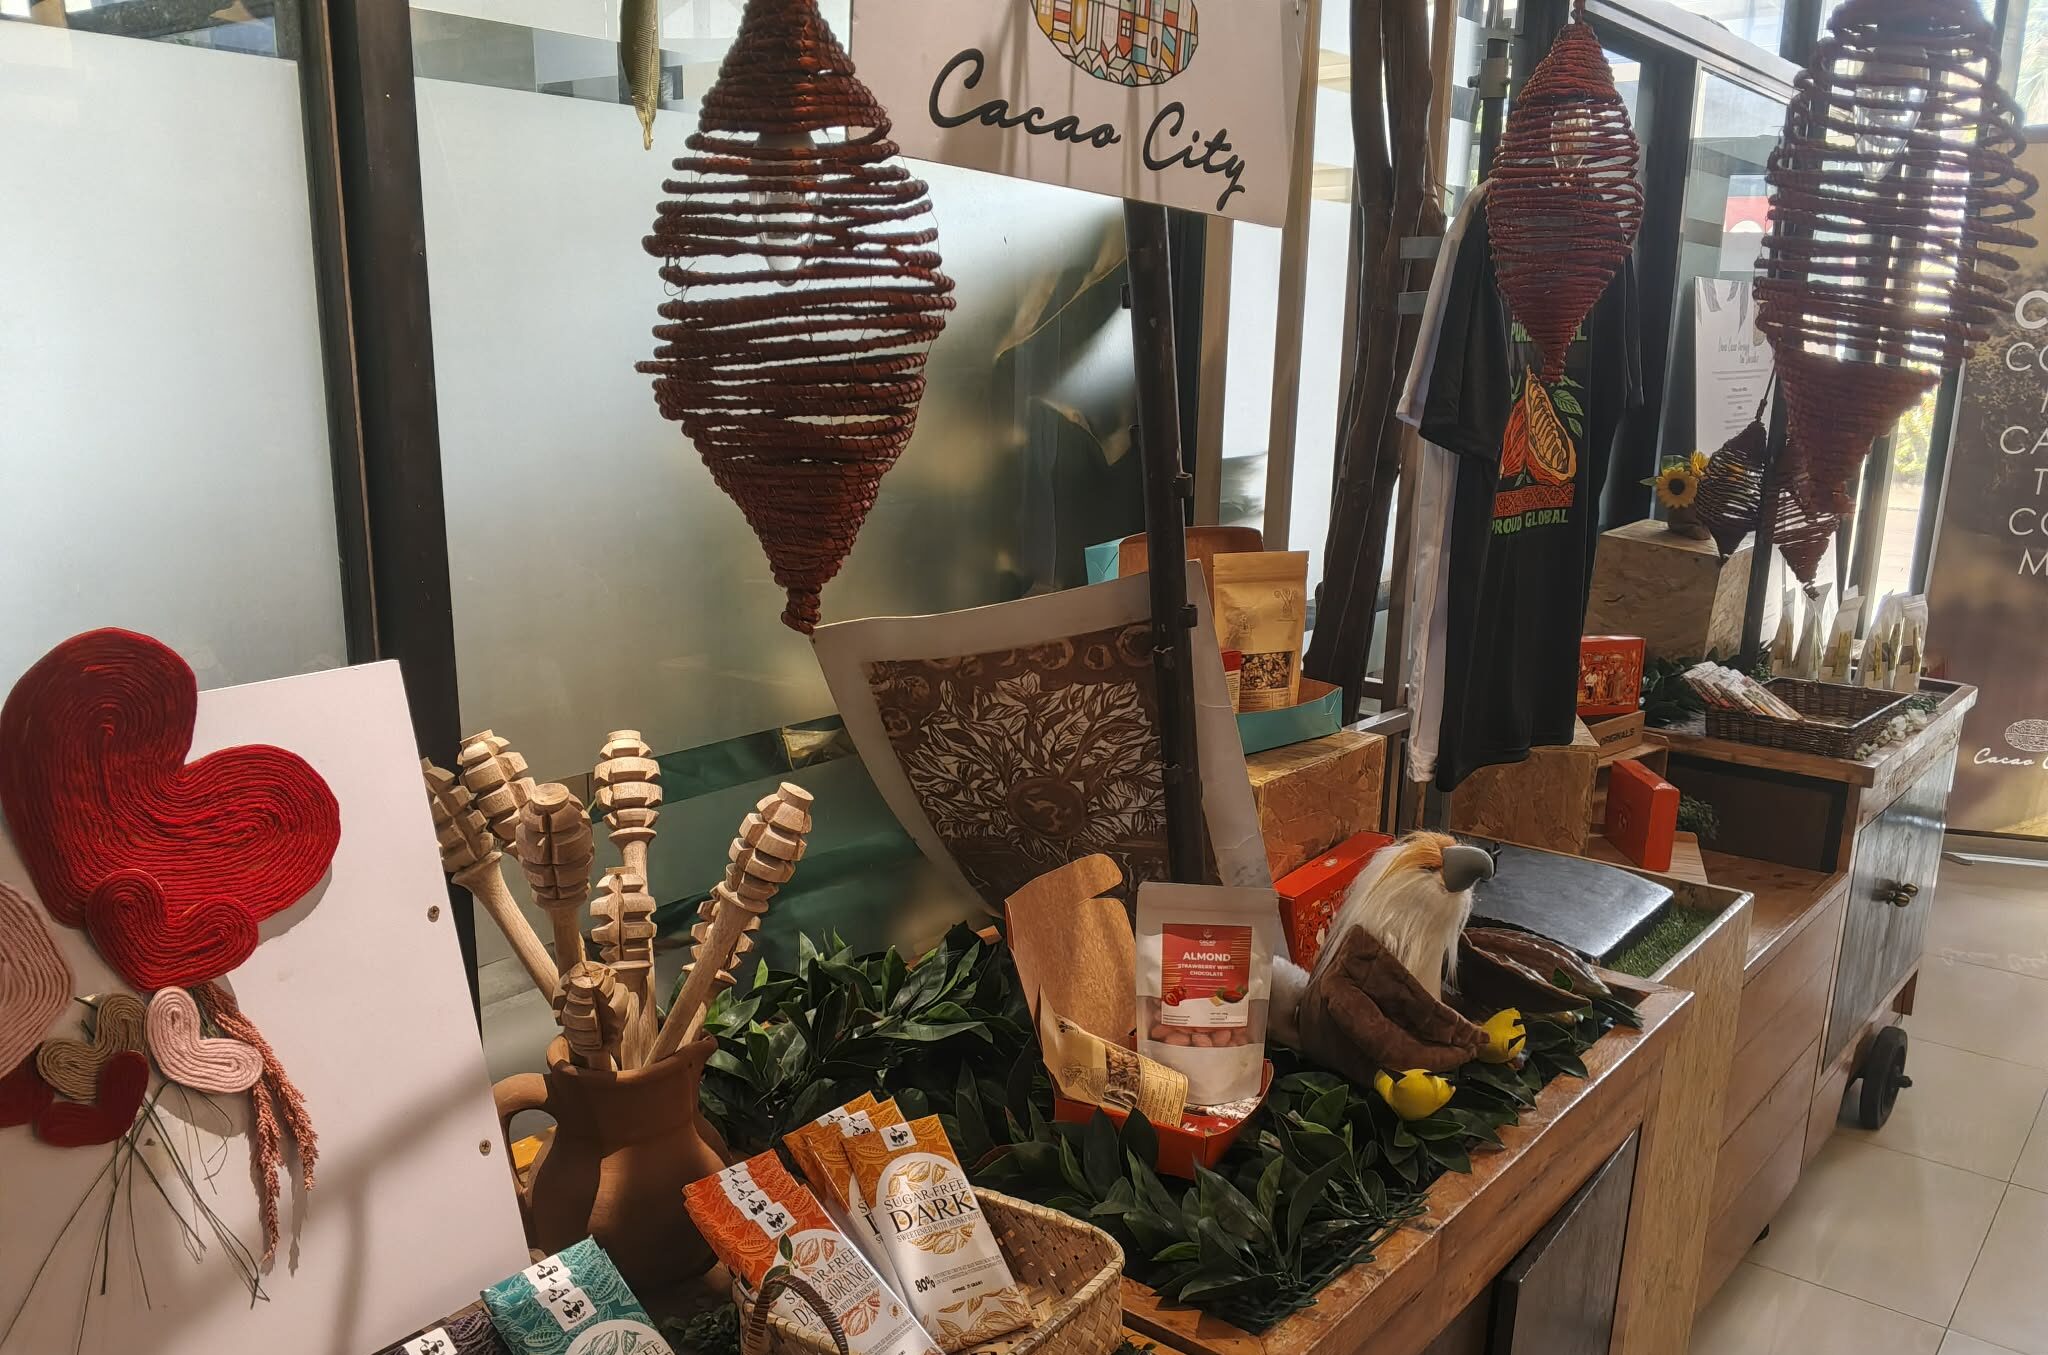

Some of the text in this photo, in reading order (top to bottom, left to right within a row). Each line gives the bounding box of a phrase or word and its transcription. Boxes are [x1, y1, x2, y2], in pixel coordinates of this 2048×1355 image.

[929, 48, 1246, 211] Cacao City
[1525, 509, 1568, 528] GLOBAL
[1974, 747, 2036, 766] Cacao
[1183, 952, 1231, 962] ALMOND
[1177, 963, 1217, 971] STRAWBERRY
[888, 1190, 978, 1235] DARK
[914, 1275, 936, 1294] 80%
